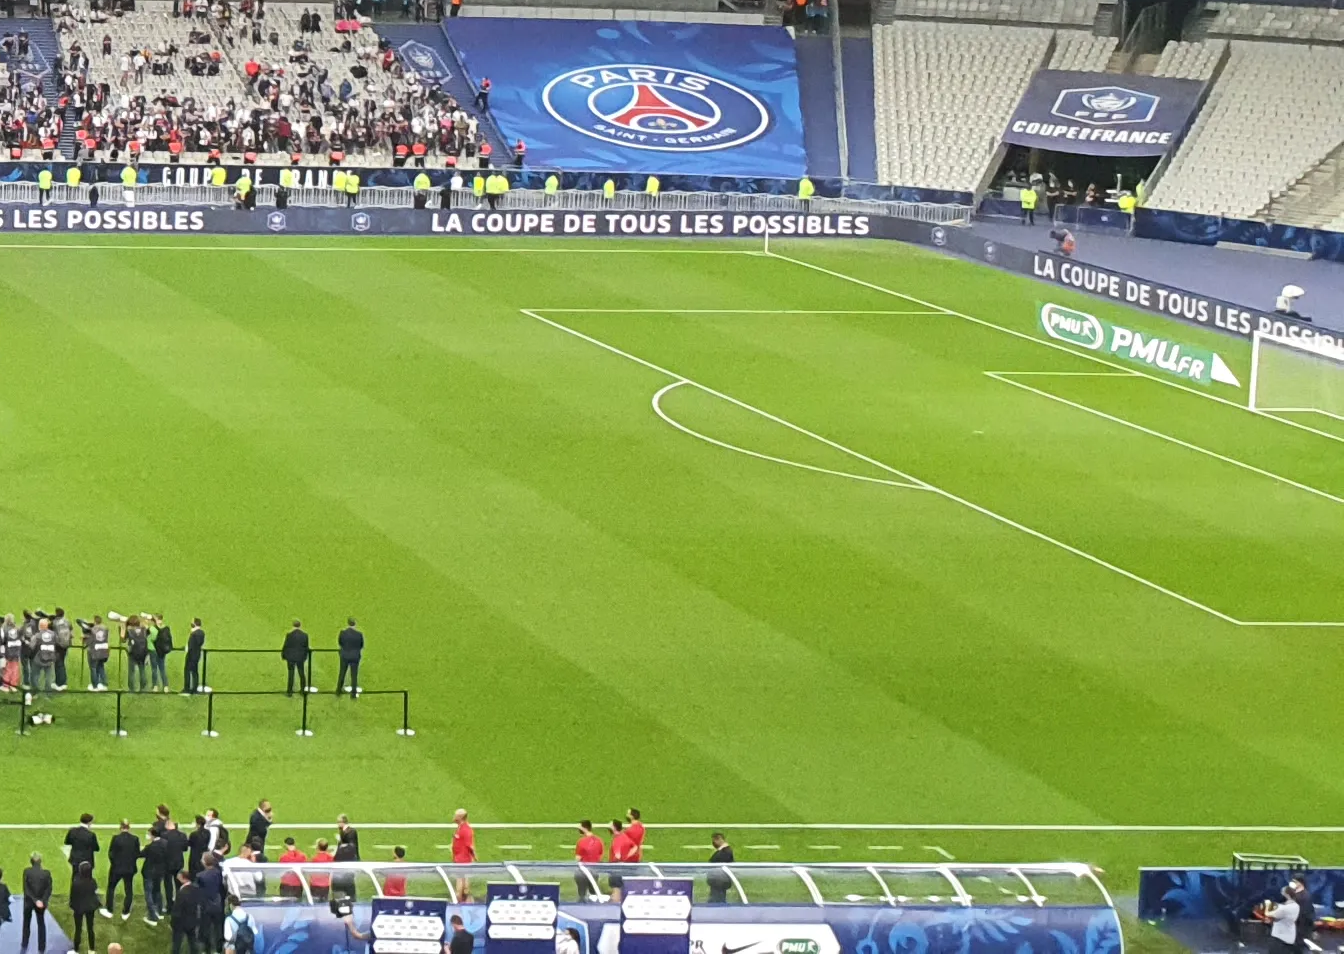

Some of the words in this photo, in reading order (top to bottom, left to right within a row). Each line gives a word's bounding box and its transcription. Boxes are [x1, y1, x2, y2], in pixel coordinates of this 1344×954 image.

[569, 68, 711, 92] PARIS
[1011, 120, 1081, 140] COUPE
[1089, 128, 1173, 145] FRANCE
[162, 166, 226, 187] COUP
[12, 206, 57, 229] LES
[66, 206, 204, 229] POSSIBLES
[431, 212, 462, 235] LA
[470, 212, 554, 235] COUPE
[563, 212, 597, 235] DE
[605, 212, 672, 235] TOUS
[679, 212, 724, 235] LES
[732, 212, 870, 235] POSSIBLES
[1033, 254, 1055, 280] LA
[1060, 262, 1120, 298] COUPE
[1125, 280, 1151, 307] DE
[1156, 288, 1210, 323] TOUS
[1215, 304, 1252, 335] LES
